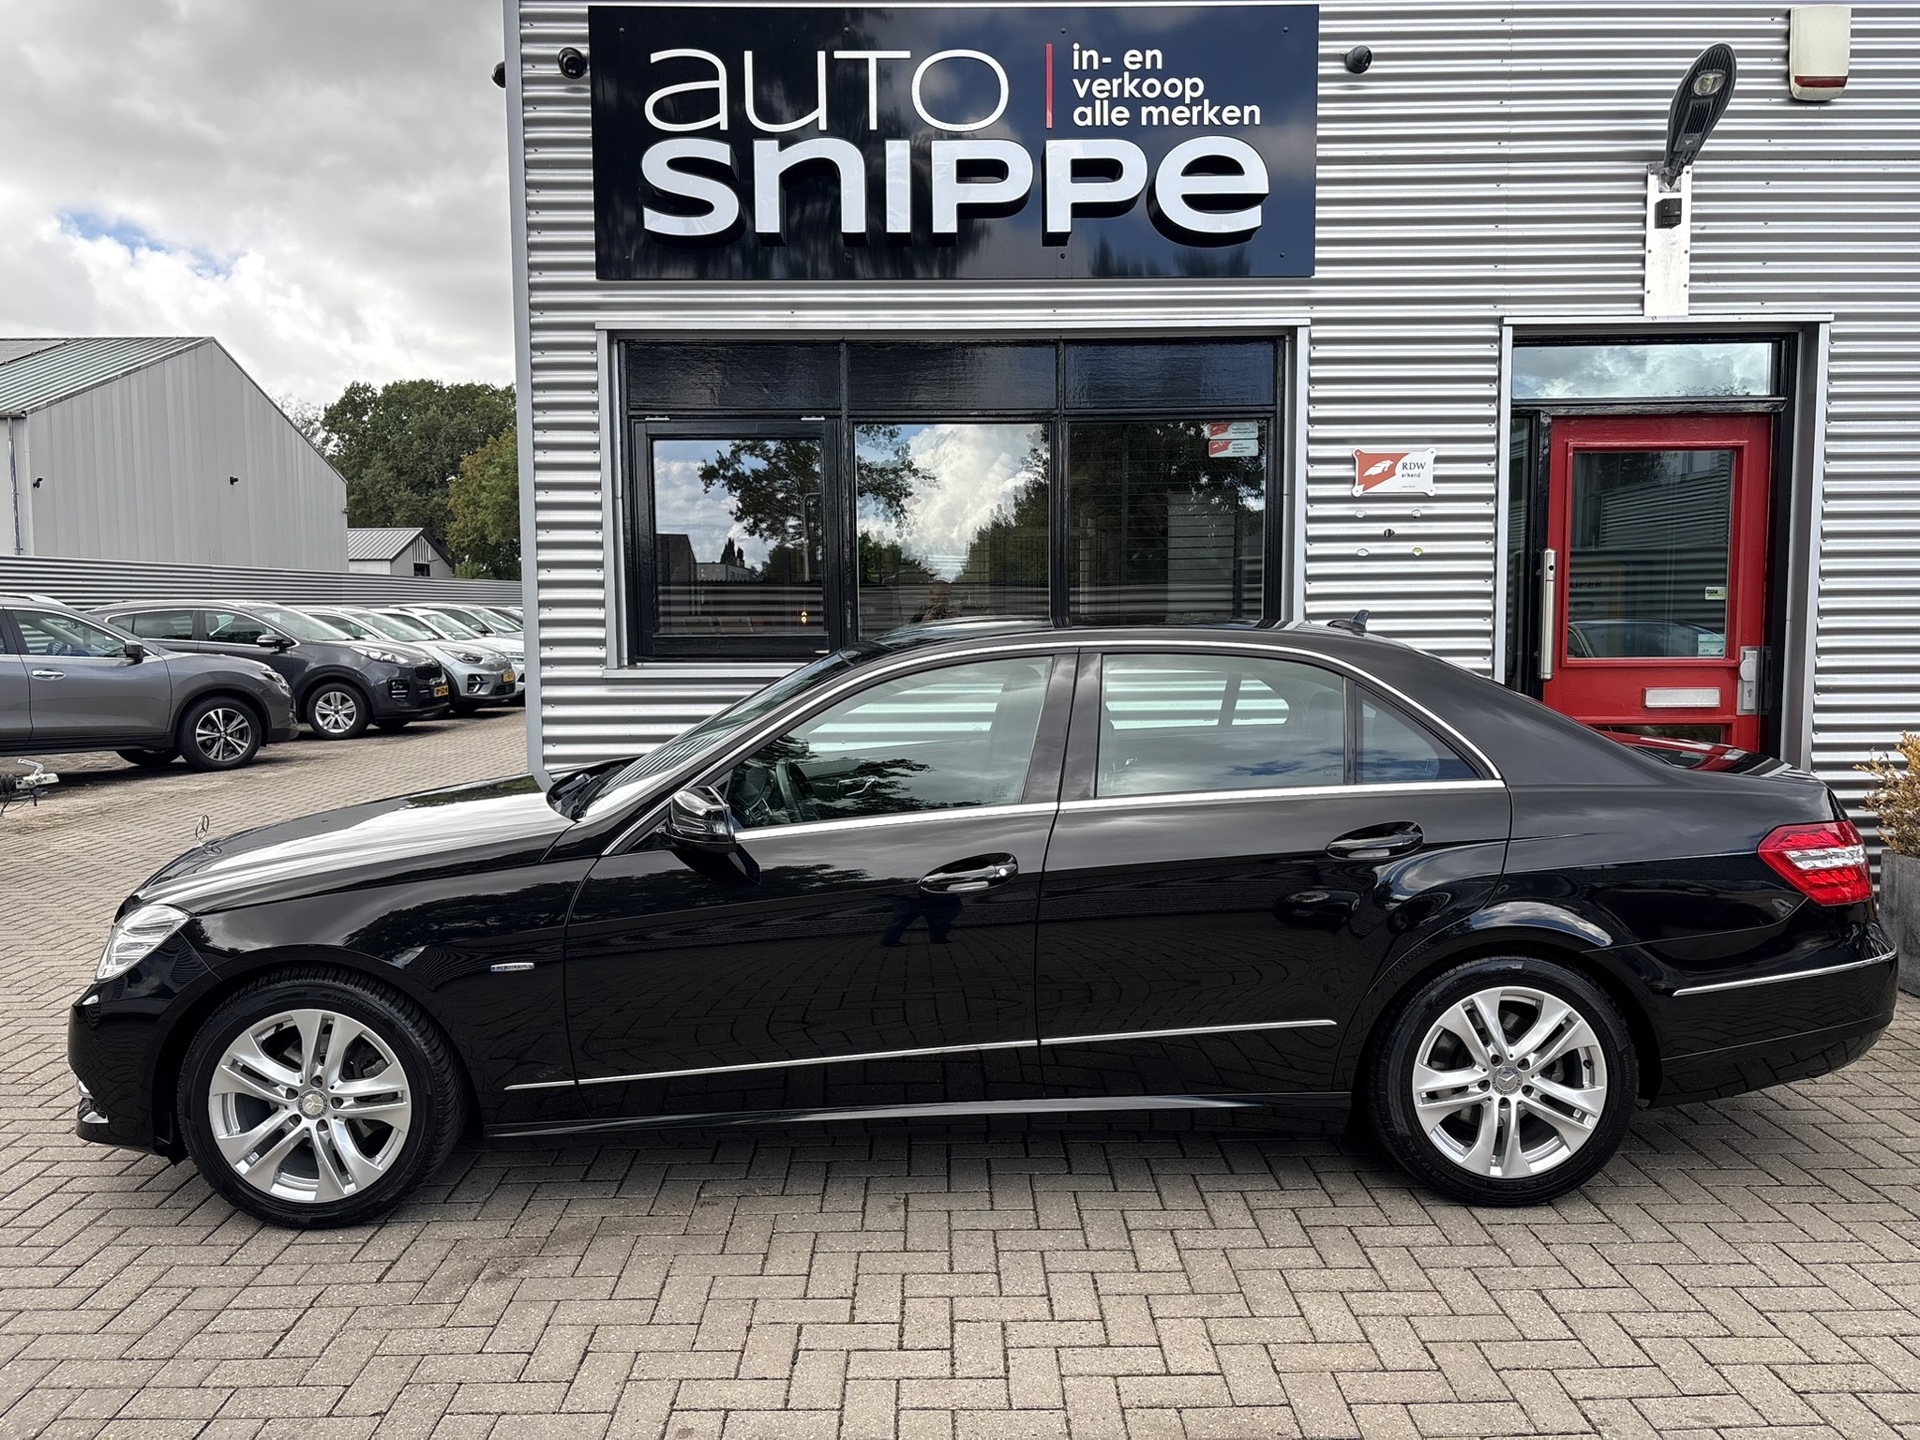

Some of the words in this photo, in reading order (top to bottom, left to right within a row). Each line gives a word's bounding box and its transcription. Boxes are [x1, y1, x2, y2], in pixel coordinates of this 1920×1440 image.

[1073, 43, 1112, 70] in-
[1123, 49, 1163, 70] en
[1073, 71, 1205, 104] verkoop
[1073, 99, 1131, 126] alle
[1141, 99, 1261, 126] merken
[1402, 462, 1427, 471] RDW
